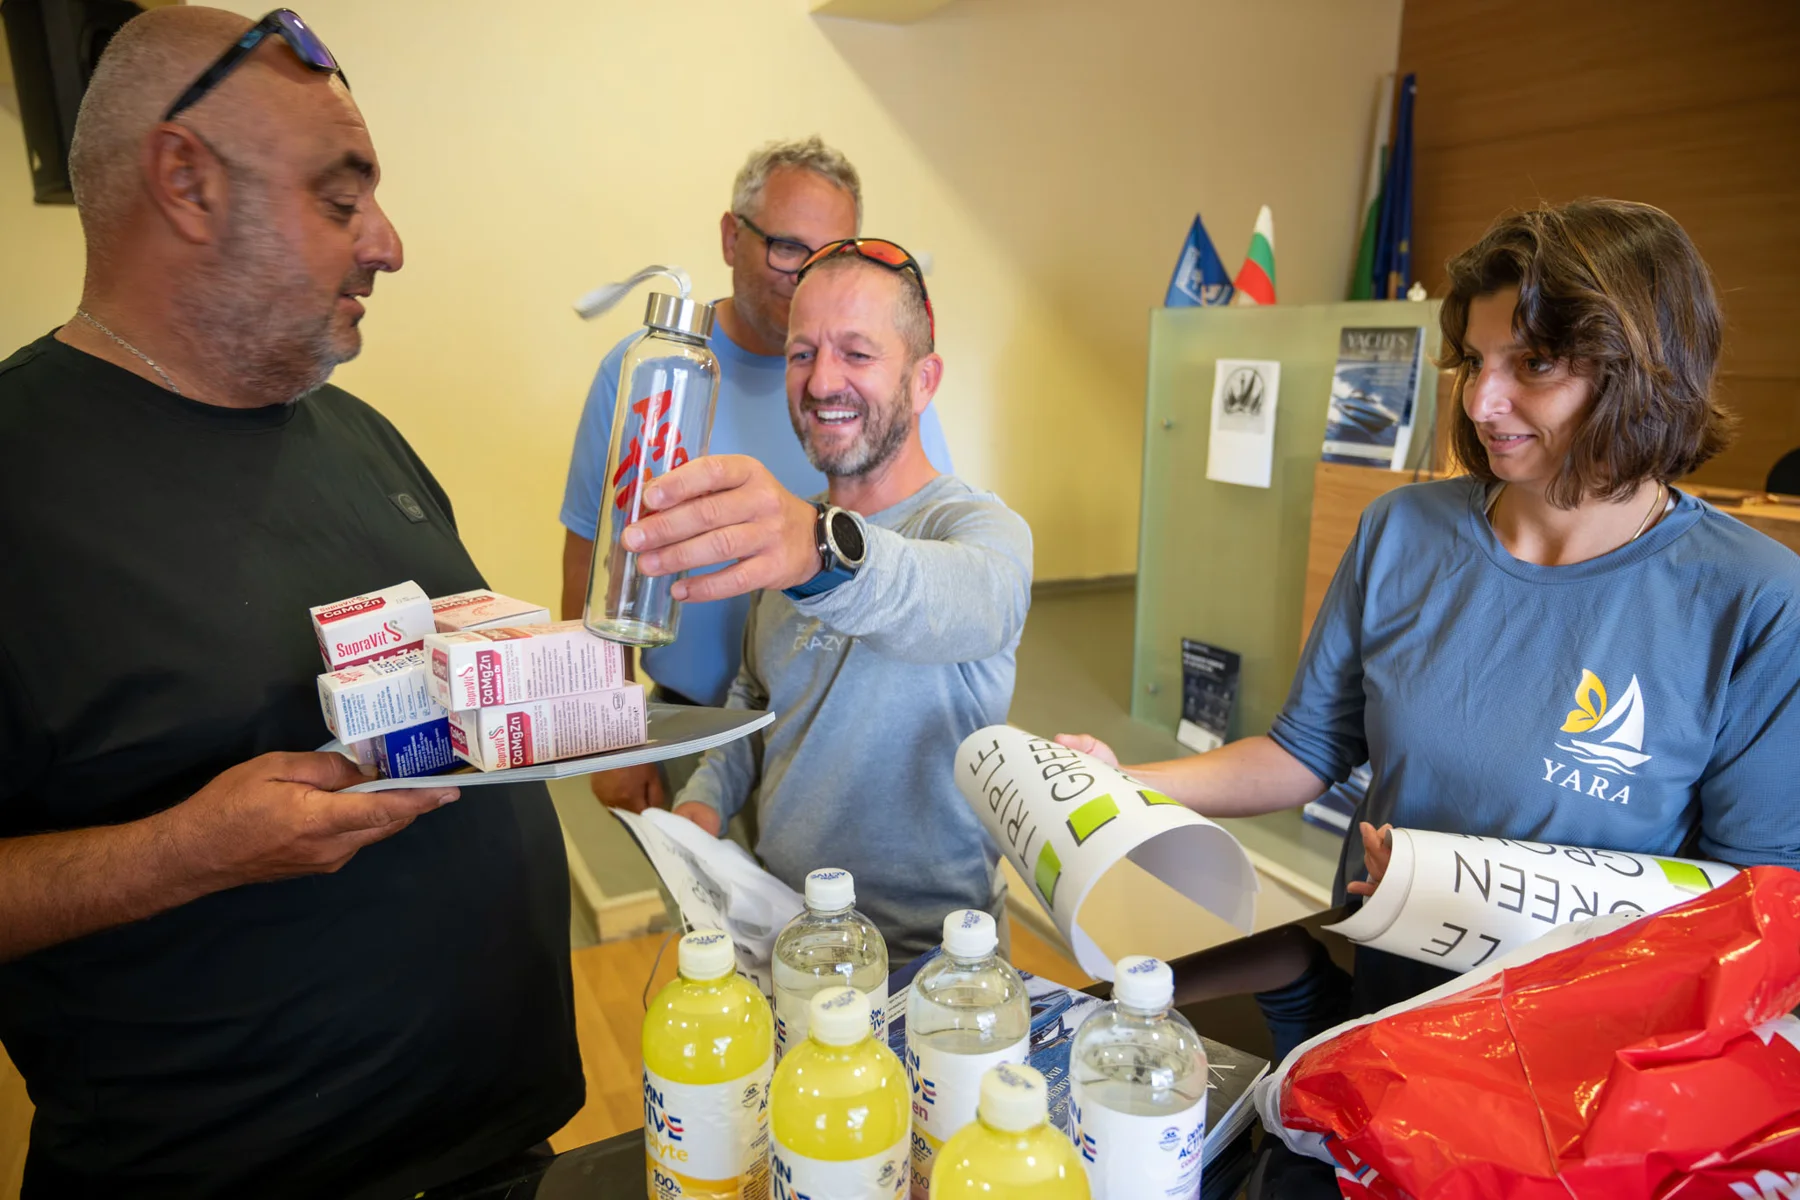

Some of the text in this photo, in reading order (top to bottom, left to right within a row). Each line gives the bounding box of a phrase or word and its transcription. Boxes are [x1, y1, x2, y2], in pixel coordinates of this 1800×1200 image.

[323, 599, 381, 619] CaMgZn
[336, 630, 388, 658] SupraVit
[464, 676, 477, 708] SupraVit
[480, 654, 494, 705] CaMgZn
[496, 737, 507, 769] SupraVit
[510, 716, 524, 766] CaMgZn
[1541, 757, 1631, 805] YARA
